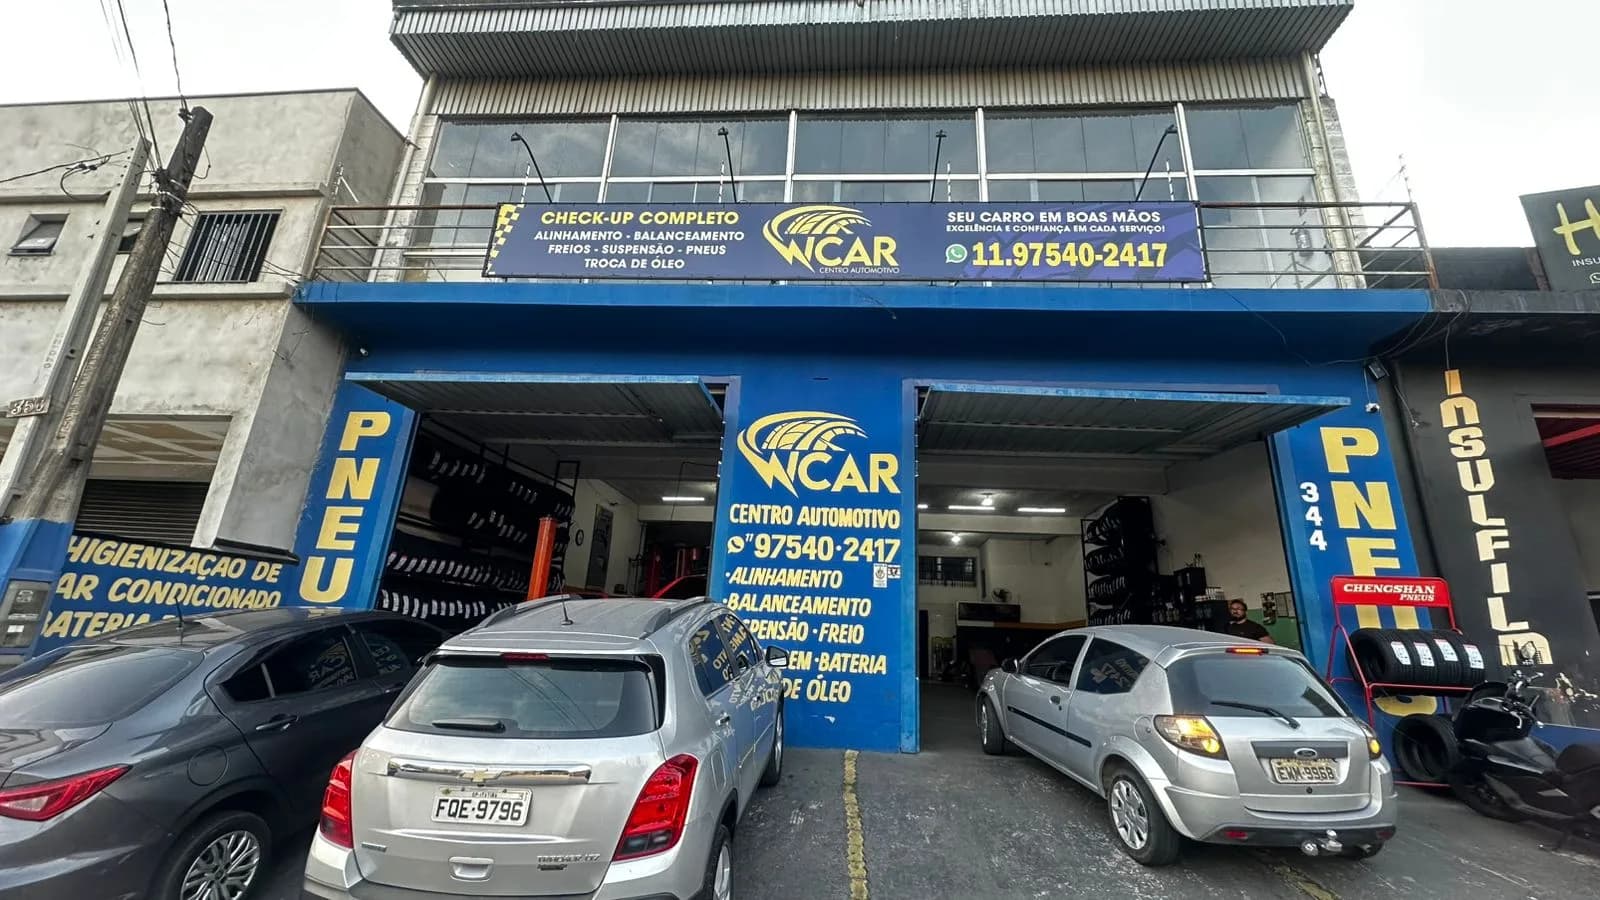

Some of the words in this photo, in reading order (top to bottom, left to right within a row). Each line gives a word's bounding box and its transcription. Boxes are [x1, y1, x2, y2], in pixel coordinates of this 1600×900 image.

[541, 211, 634, 225] CHECK-UP
[639, 211, 739, 225] COMPLETO
[947, 211, 975, 223] SEU
[980, 211, 1035, 223] CARRO
[1039, 211, 1062, 223] EM
[1067, 211, 1108, 223] BOAS
[1113, 209, 1161, 223] MÃOS
[534, 230, 622, 241] ALINHAMENTO
[633, 230, 745, 241] BALANCEAMENTO
[946, 224, 1003, 233] EXCELÊNCIA
[1005, 225, 1011, 233] E
[1012, 225, 1071, 234] CONFIANÇA
[1073, 225, 1087, 233] EM
[1089, 225, 1117, 233] CADA
[1120, 225, 1165, 235] SERVIÇO!
[548, 244, 591, 254] FREIOS
[601, 242, 674, 255] SUSPENSÃO
[686, 245, 726, 255] PNEUS
[972, 242, 1168, 268] 11.97540-2417
[584, 259, 627, 269] TROCA
[631, 259, 648, 269] DE
[651, 256, 685, 269] ÓLEO
[299, 411, 391, 608] PNEU
[729, 503, 793, 526] CENTRO
[797, 506, 900, 530] AUTOMOTIVO
[251, 561, 283, 584] DE
[729, 566, 843, 589] ALINHAMENTO
[55, 572, 99, 600] AR
[108, 577, 281, 609] CONDICIONADO
[1343, 583, 1435, 595] CHENGSHAN
[1400, 593, 1435, 602] PNEUS
[727, 592, 872, 617] BALANCEAMENTO
[743, 617, 809, 642] PENSÃO
[818, 623, 865, 645] FREIO
[818, 651, 887, 675] BATERIA
[806, 674, 852, 703] ÓLEO
